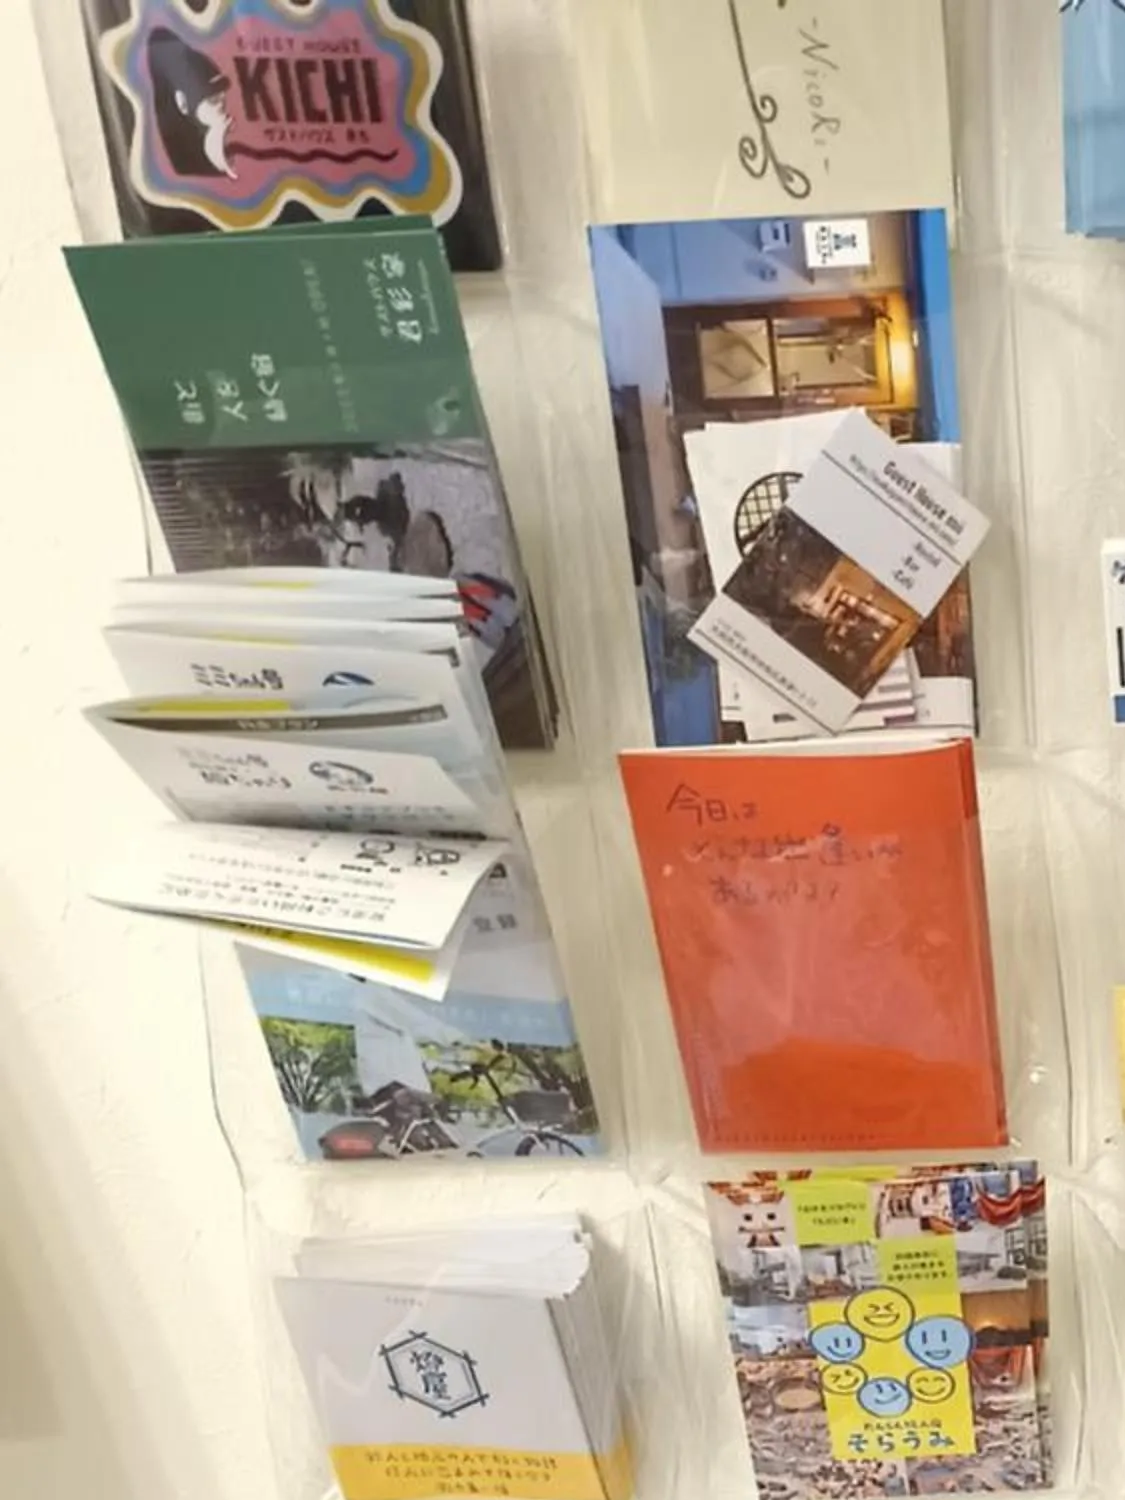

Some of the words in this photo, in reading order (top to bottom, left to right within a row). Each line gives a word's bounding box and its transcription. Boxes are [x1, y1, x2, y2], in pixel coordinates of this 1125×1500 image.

[232, 56, 384, 125] KICHI
[848, 1431, 956, 1453] そらうみ
